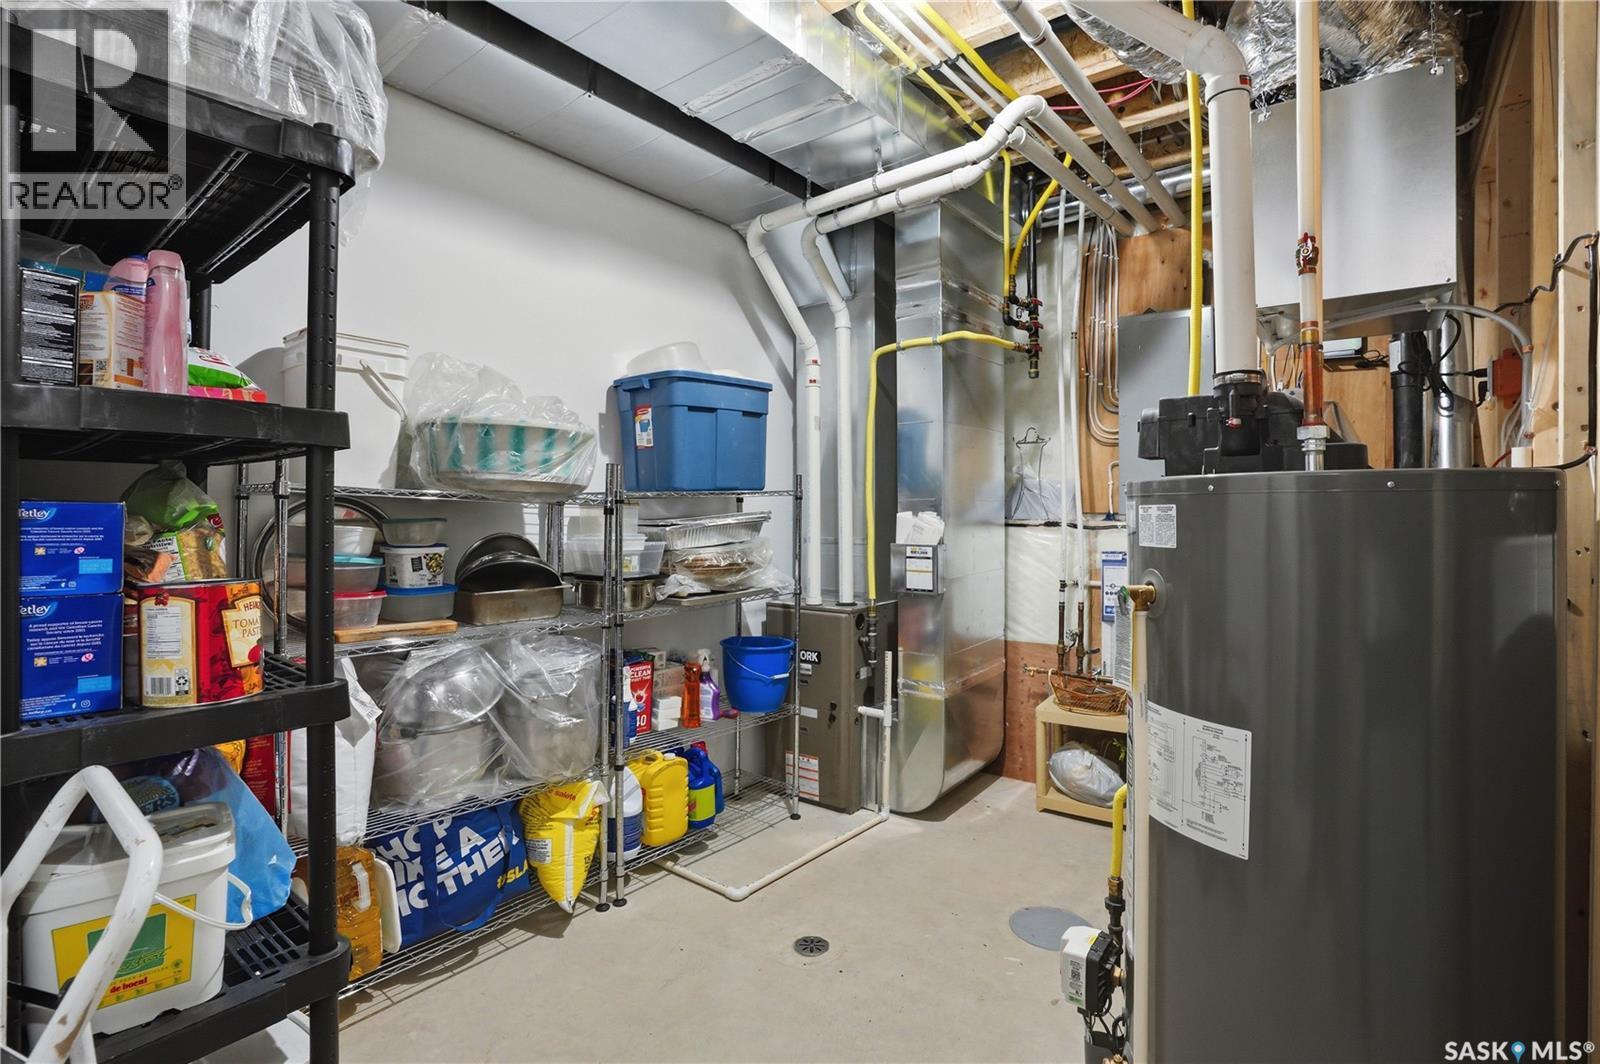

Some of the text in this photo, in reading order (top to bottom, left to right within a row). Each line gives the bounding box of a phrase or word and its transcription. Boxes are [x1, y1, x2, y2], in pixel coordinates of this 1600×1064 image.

[19, 604, 52, 617] etley
[243, 601, 261, 612] HEIN
[232, 617, 260, 629] TOMA
[799, 650, 819, 662] ORK
[375, 814, 453, 861] HOP
[393, 842, 454, 887] IKE
[459, 825, 487, 858] A
